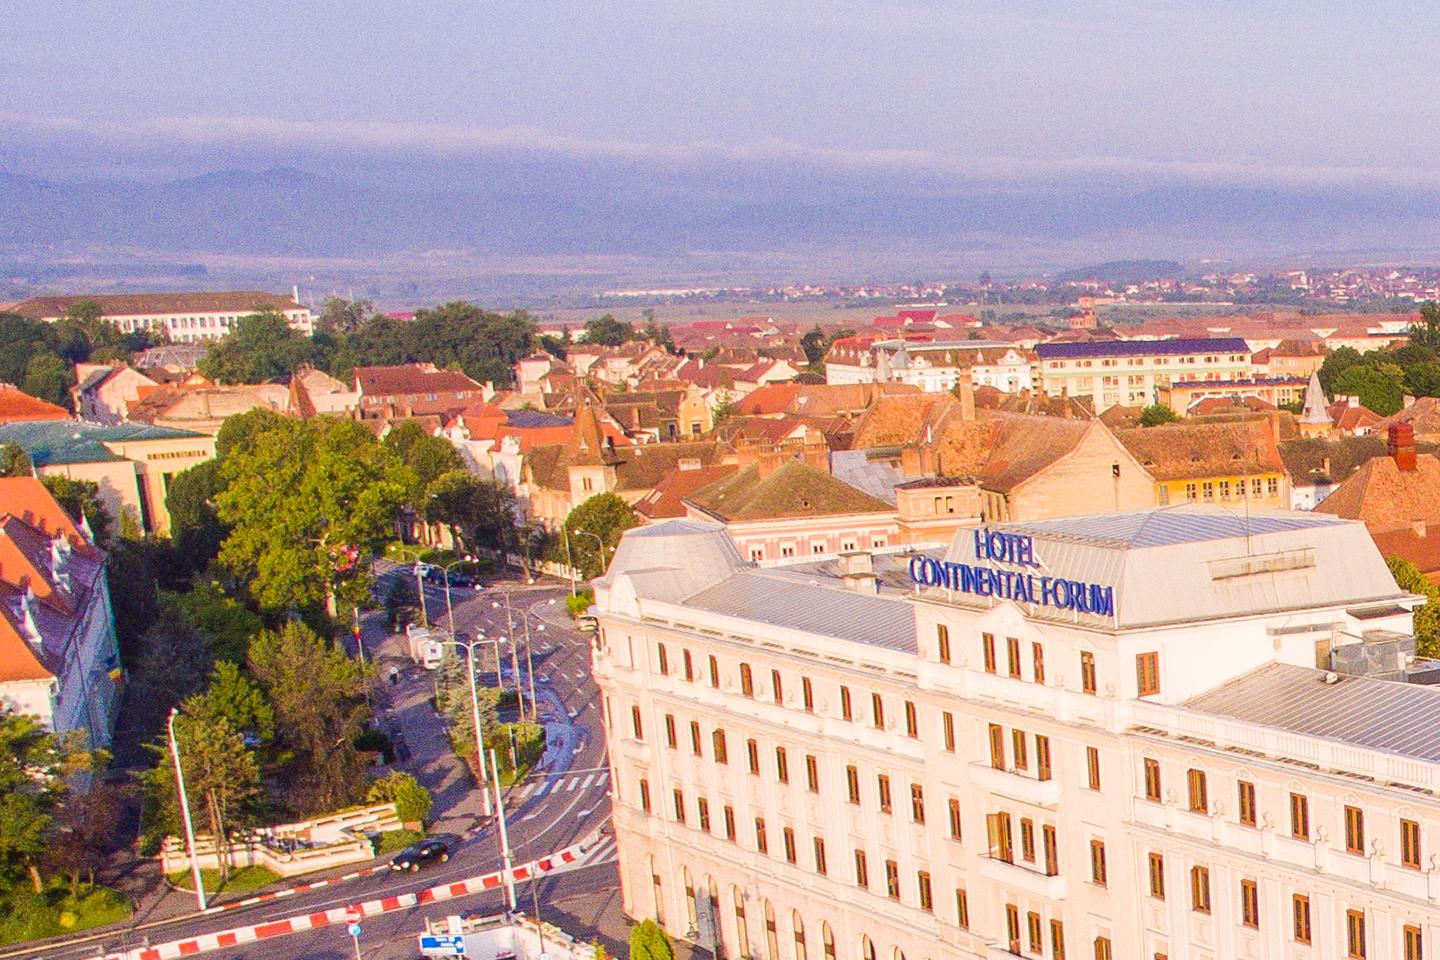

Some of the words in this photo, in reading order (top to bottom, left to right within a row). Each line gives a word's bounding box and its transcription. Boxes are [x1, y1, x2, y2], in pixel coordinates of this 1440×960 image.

[974, 528, 1041, 569] HOTEL
[909, 556, 1040, 606] CONTINENTAL
[1042, 576, 1115, 617] FORUM
